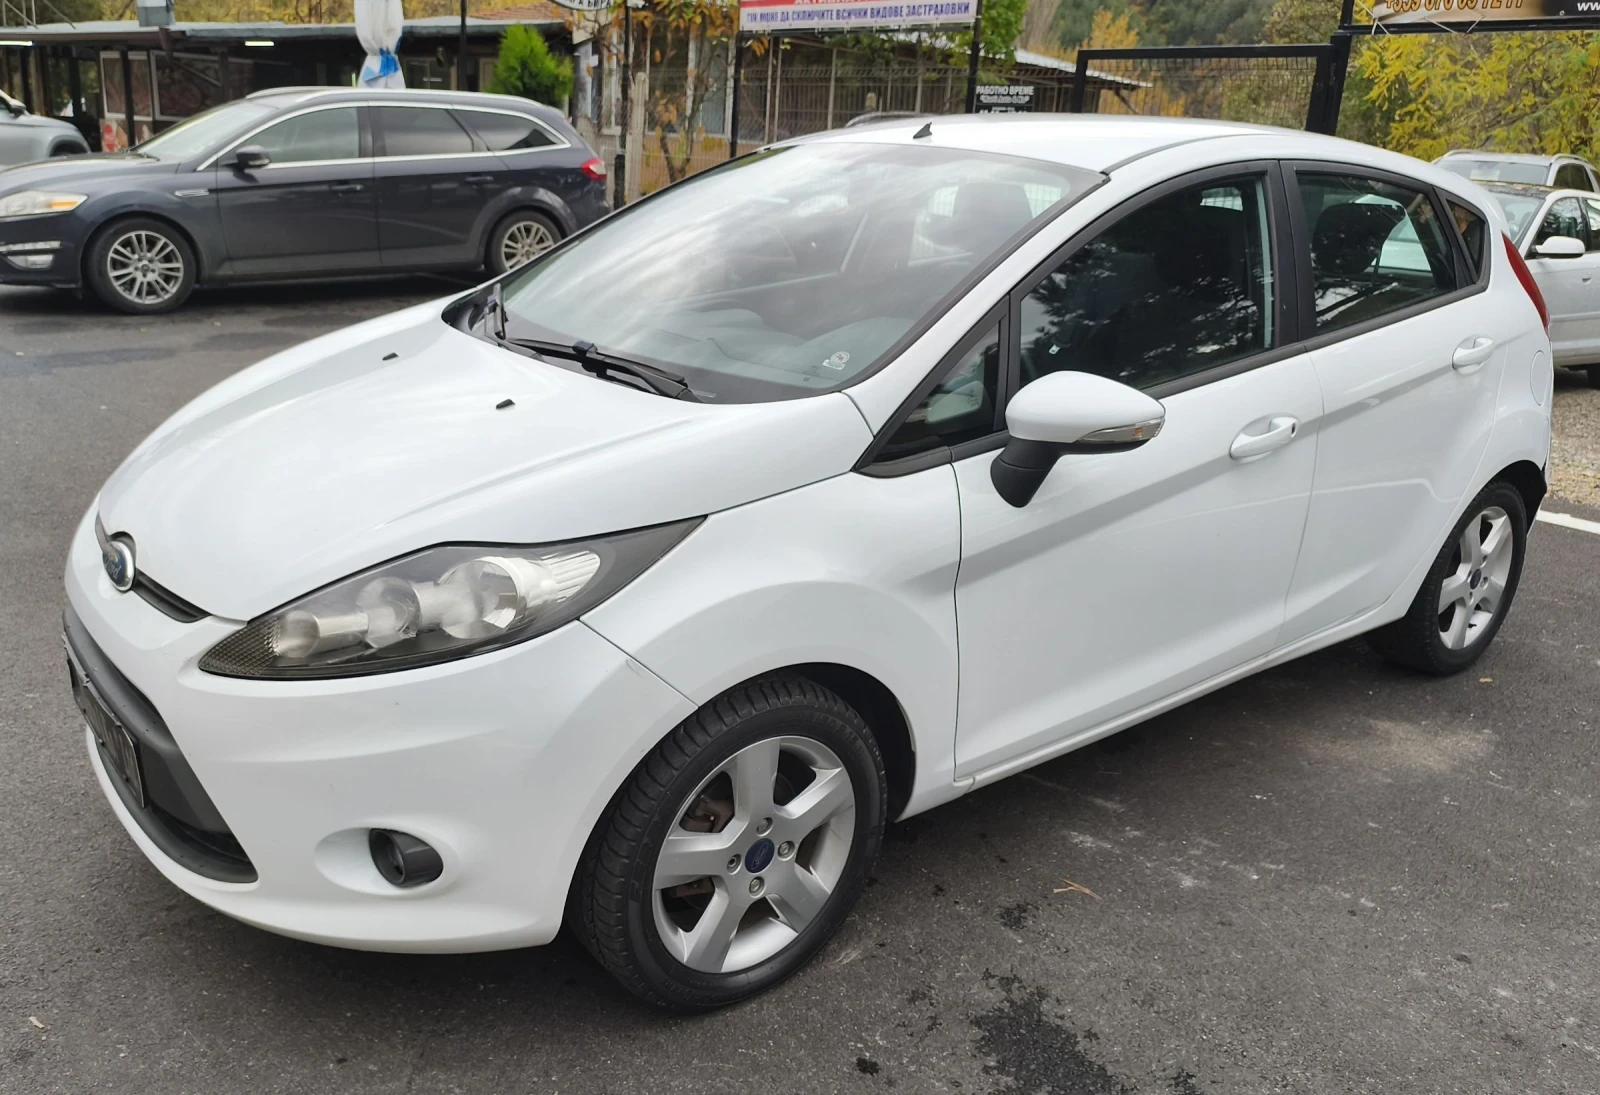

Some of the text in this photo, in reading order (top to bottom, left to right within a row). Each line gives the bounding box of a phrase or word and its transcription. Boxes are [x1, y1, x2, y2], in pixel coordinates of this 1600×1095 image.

[781, 11, 790, 21] ДА
[836, 8, 868, 20] ВСИЧКИ
[870, 6, 903, 19] ВИДОВЕ
[906, 2, 970, 17] ЗАСТРАХОВКИ
[976, 85, 1034, 95] РАБОТНО ВРЕМЕ
